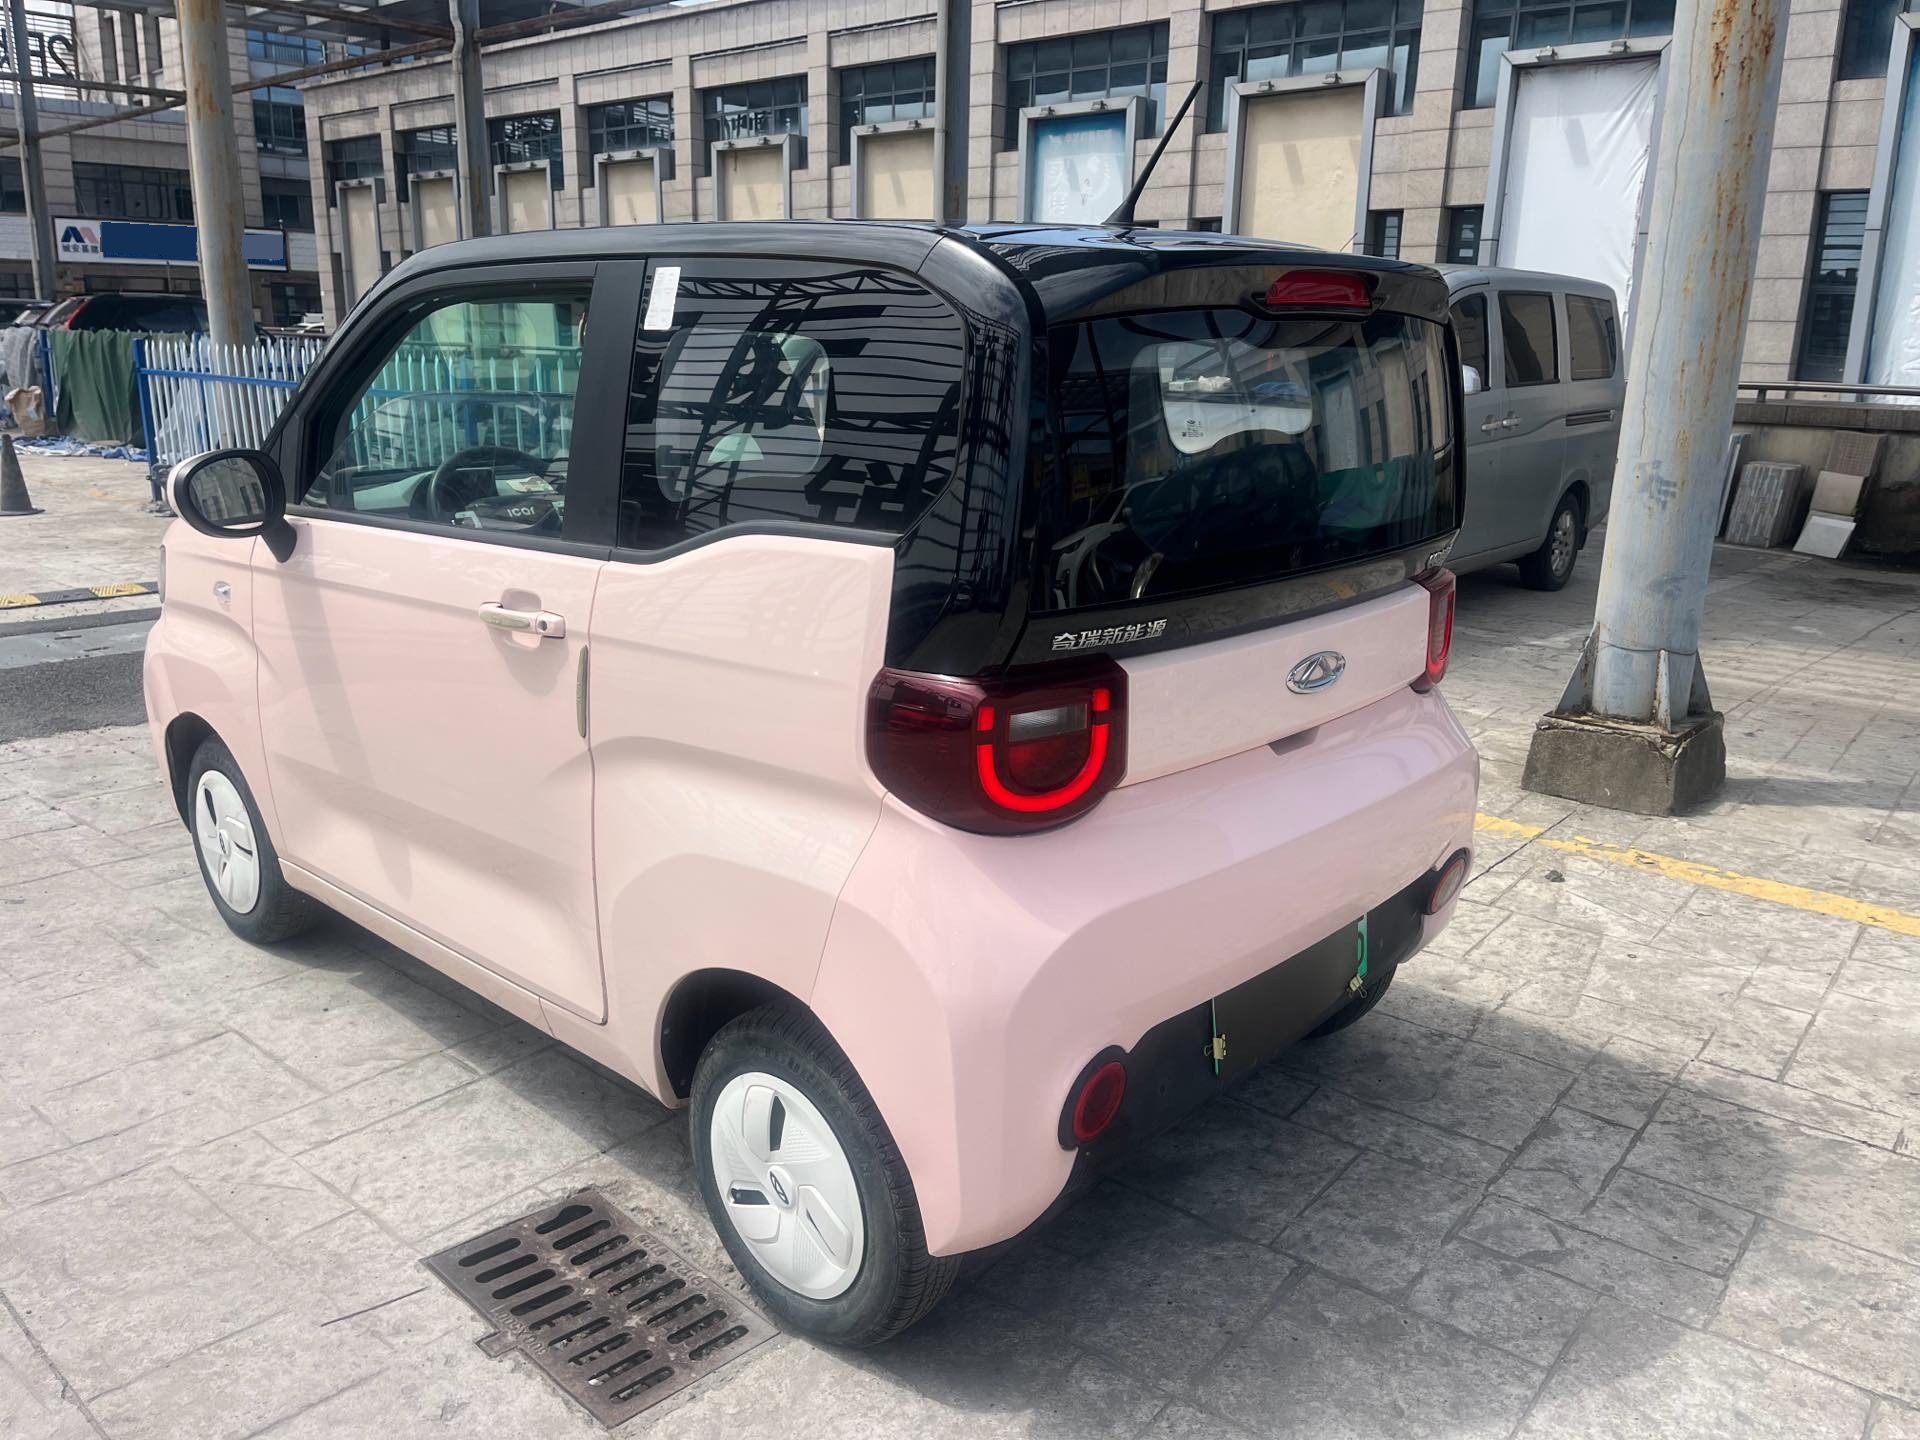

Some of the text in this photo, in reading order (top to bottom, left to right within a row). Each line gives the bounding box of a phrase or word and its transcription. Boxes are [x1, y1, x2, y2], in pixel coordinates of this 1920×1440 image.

[1051, 618, 1168, 651] 奇瑞新能源
